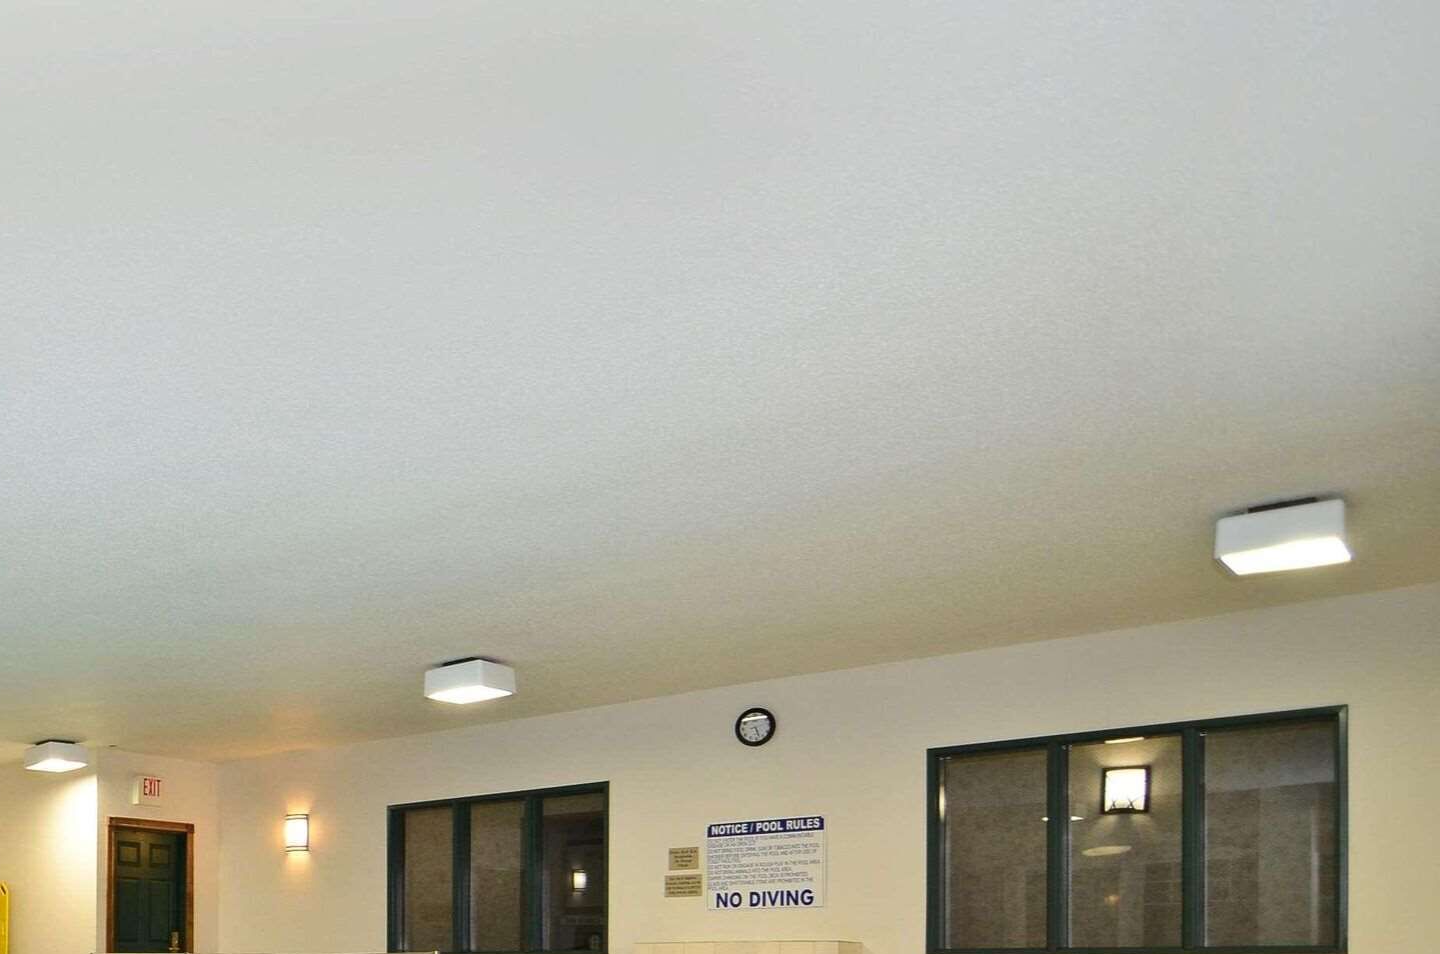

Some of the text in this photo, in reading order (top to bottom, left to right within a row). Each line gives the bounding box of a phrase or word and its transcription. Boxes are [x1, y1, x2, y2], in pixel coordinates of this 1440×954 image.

[144, 777, 160, 797] EXIT
[711, 822, 748, 836] NOTICE
[756, 819, 783, 833] POOL
[786, 817, 820, 831] RULES
[716, 889, 814, 908] NO DIVING
